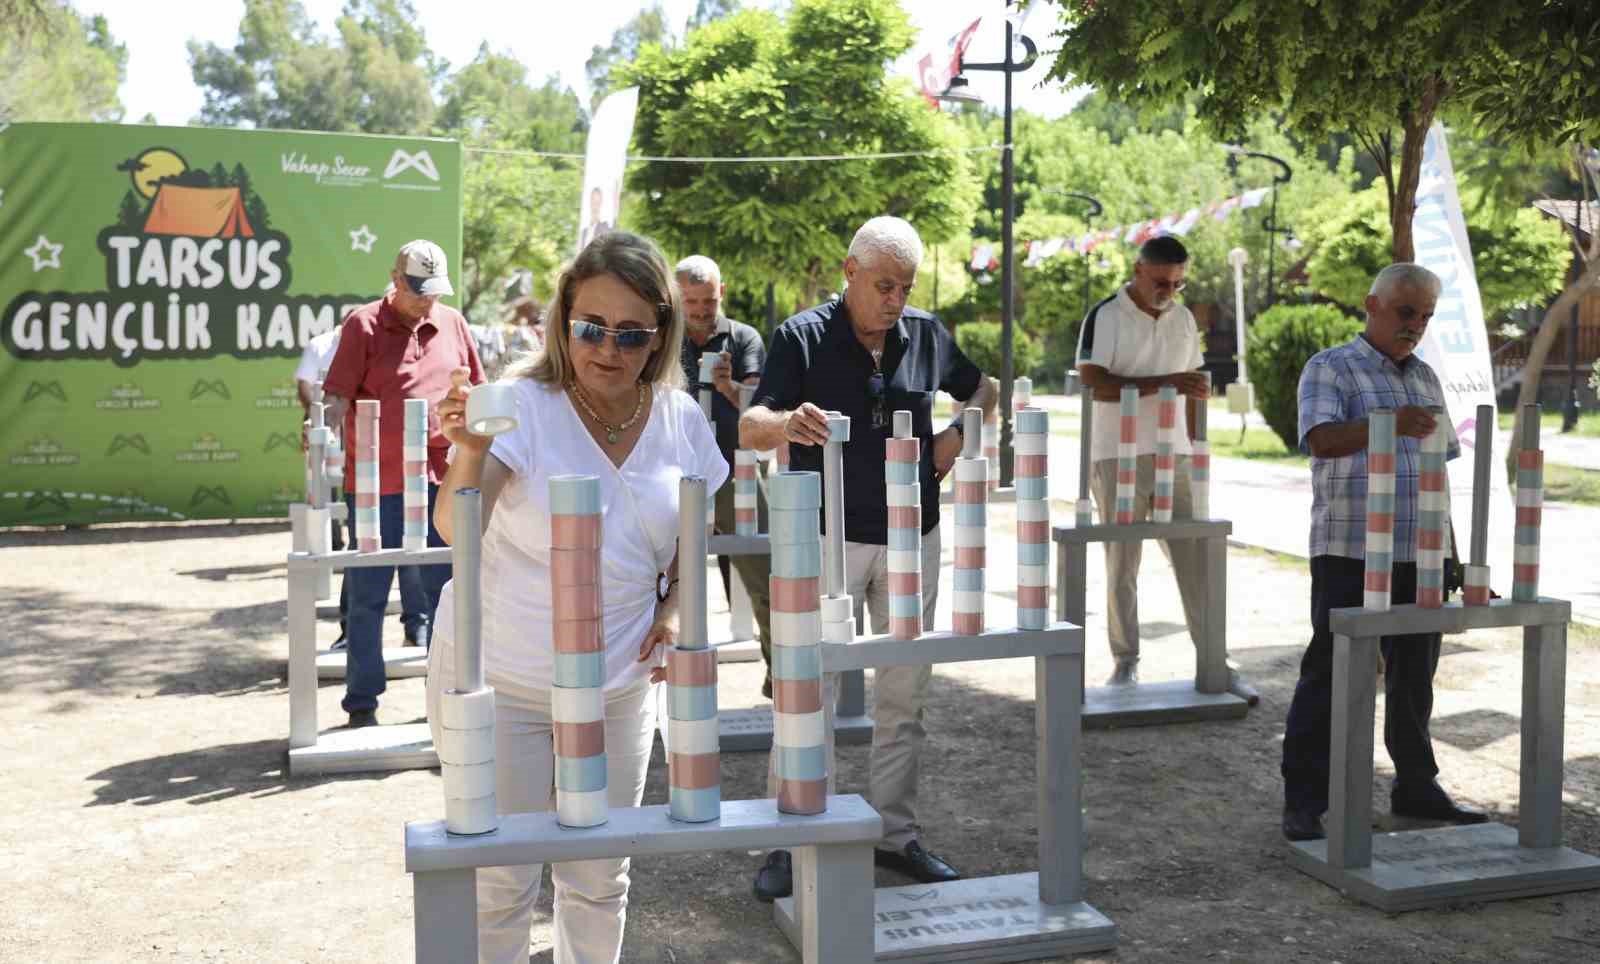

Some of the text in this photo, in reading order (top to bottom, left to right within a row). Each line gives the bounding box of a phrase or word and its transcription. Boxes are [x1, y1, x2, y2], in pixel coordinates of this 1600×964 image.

[281, 151, 329, 184] Vahap
[108, 236, 282, 290] TARSUS
[11, 292, 360, 358] GENÇLİK KAM
